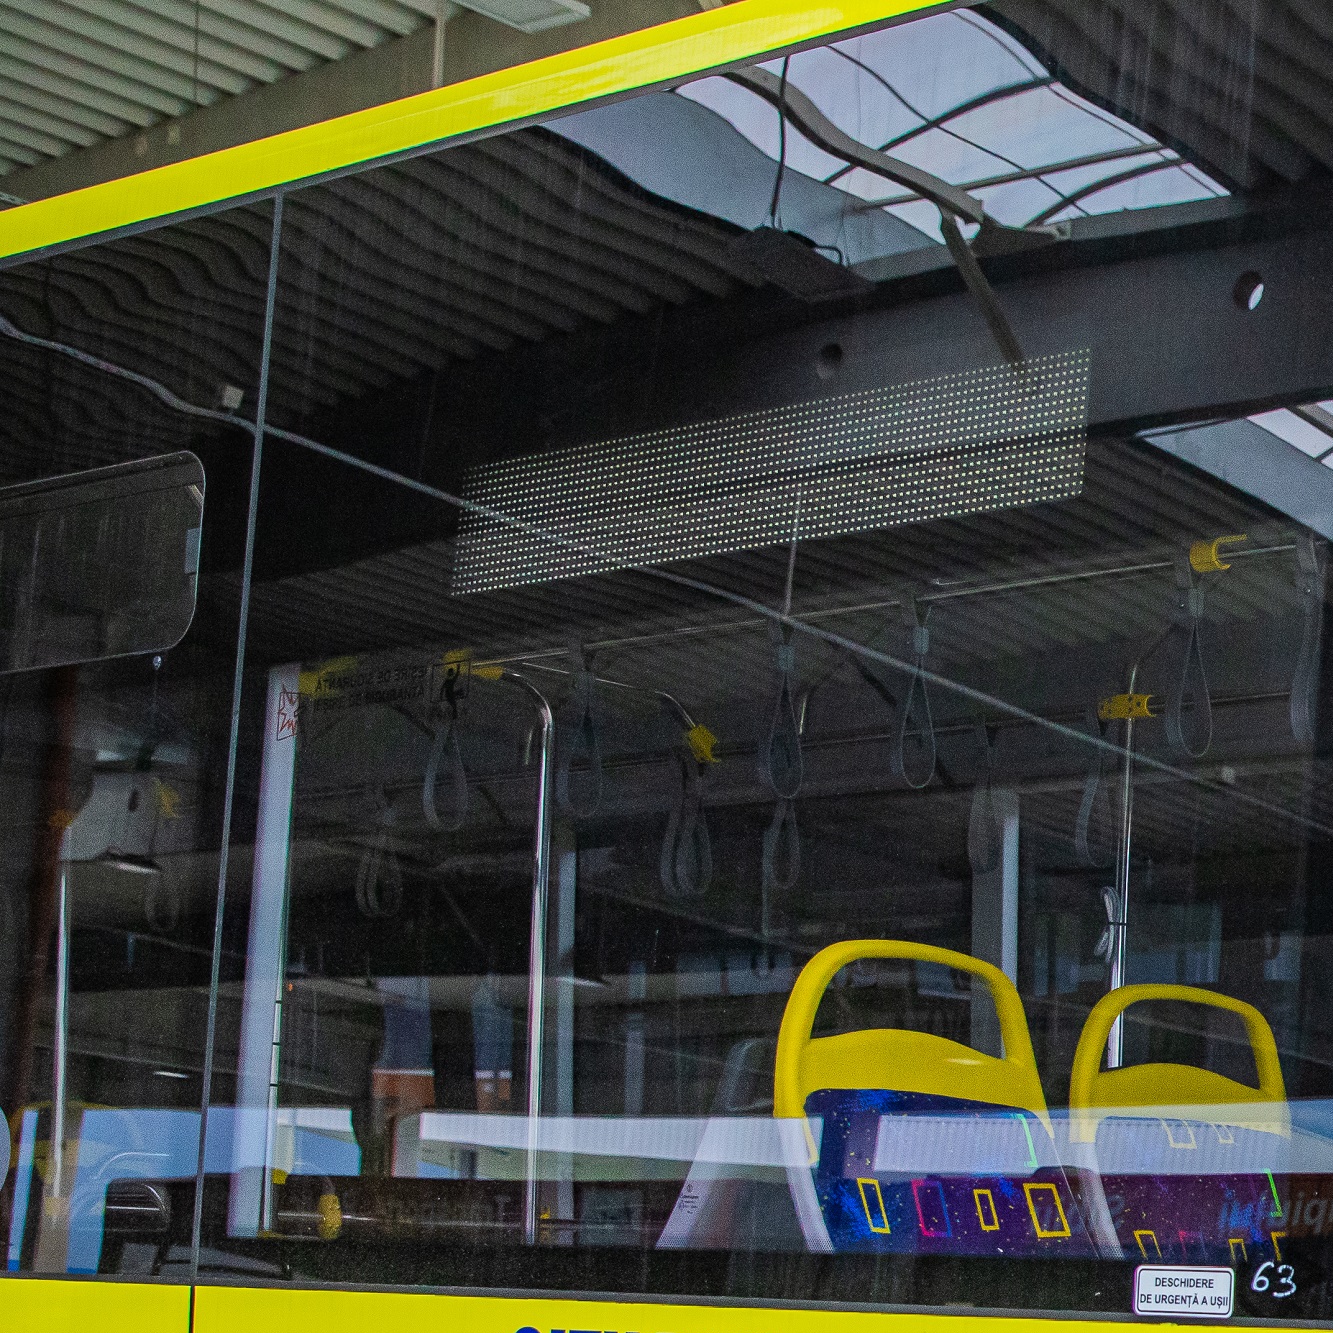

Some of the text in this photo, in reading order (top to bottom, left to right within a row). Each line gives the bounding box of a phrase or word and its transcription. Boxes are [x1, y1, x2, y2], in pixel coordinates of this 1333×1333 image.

[1155, 1277, 1214, 1289] DESCHIDERE
[1251, 1261, 1297, 1298] 63
[1140, 1293, 1228, 1309] DE URGENȚĂ A UȘII
